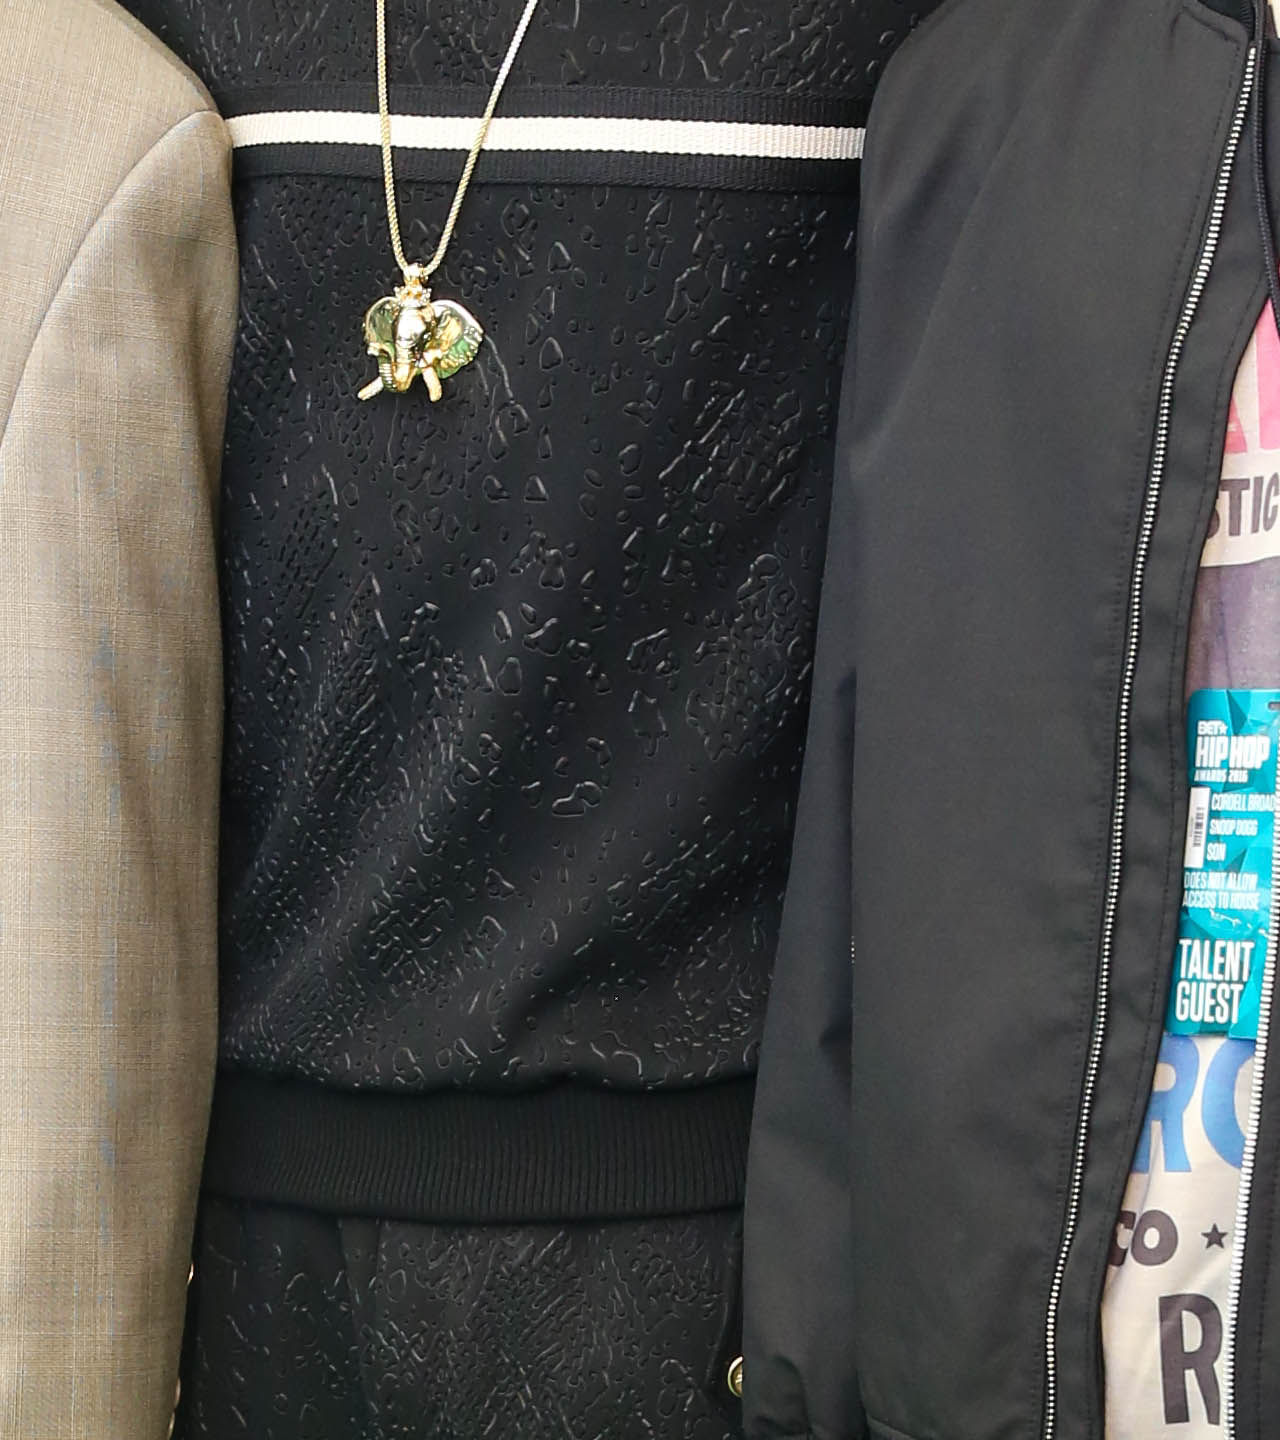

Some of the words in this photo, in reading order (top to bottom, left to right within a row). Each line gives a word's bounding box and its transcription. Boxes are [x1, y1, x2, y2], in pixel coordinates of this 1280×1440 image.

[1195, 735, 1229, 768] HIP
[1229, 735, 1271, 769] HOP
[1209, 818, 1235, 835] SNOOP
[1235, 819, 1259, 836] DOGG
[1207, 843, 1227, 861] SON
[1183, 871, 1207, 888] DOES
[1207, 872, 1227, 890] NOT
[1227, 873, 1259, 891] ALLOW
[1182, 890, 1216, 908] ACCESS
[1218, 891, 1228, 908] TO
[1229, 892, 1260, 910] HOUSE
[1178, 938, 1256, 982] TALENT
[1175, 980, 1244, 1024] GUEST
